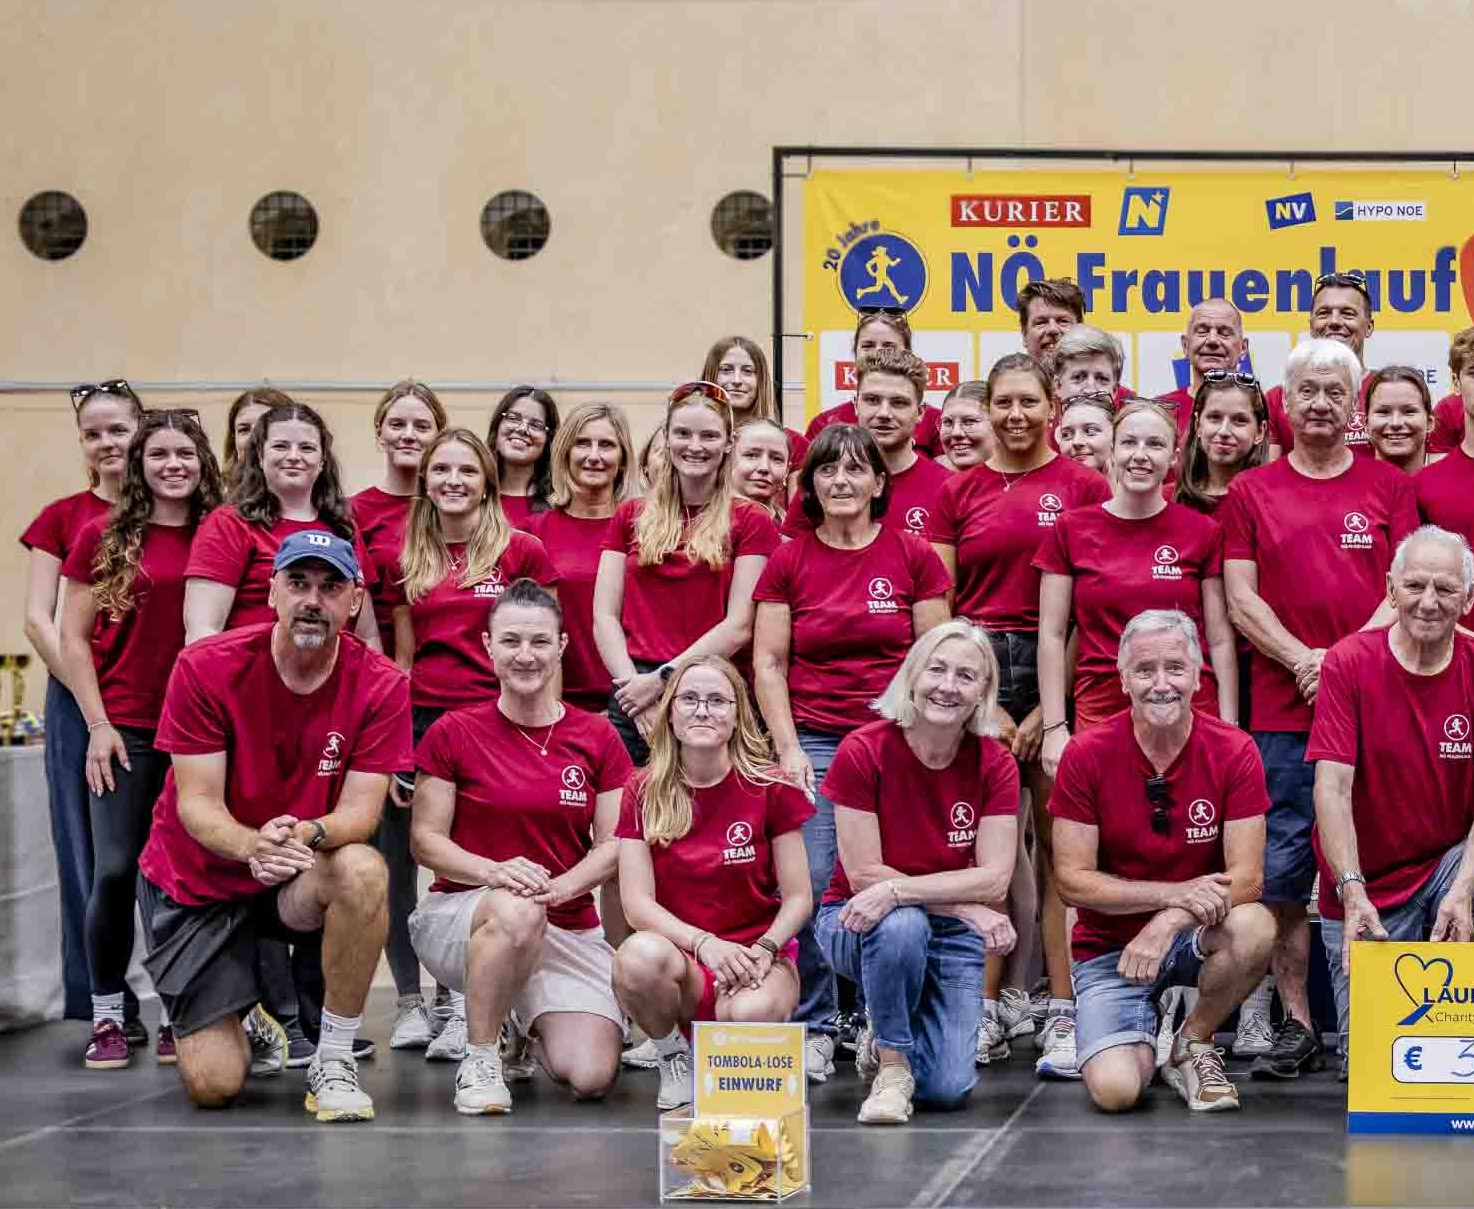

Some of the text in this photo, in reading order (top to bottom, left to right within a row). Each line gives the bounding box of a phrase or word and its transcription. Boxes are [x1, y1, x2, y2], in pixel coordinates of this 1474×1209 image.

[958, 200, 1085, 222] KURIER
[1275, 202, 1308, 220] NV
[1357, 205, 1423, 216] HYPO NOE
[823, 248, 841, 272] 20
[1037, 512, 1060, 521] TEA
[1340, 533, 1373, 544] TEAM
[1152, 564, 1182, 575] TEAM
[474, 584, 505, 594] TEAM
[867, 600, 898, 609] TEAM
[1439, 741, 1472, 753] TEAM
[559, 789, 587, 802] TEAM
[947, 830, 977, 842] TEAM
[1185, 825, 1218, 839] TEAM
[722, 845, 756, 860] TEAM
[707, 1055, 793, 1069] TOMBOLA-LOSE
[1403, 1045, 1423, 1071] €
[718, 1077, 783, 1092] EINWURF
